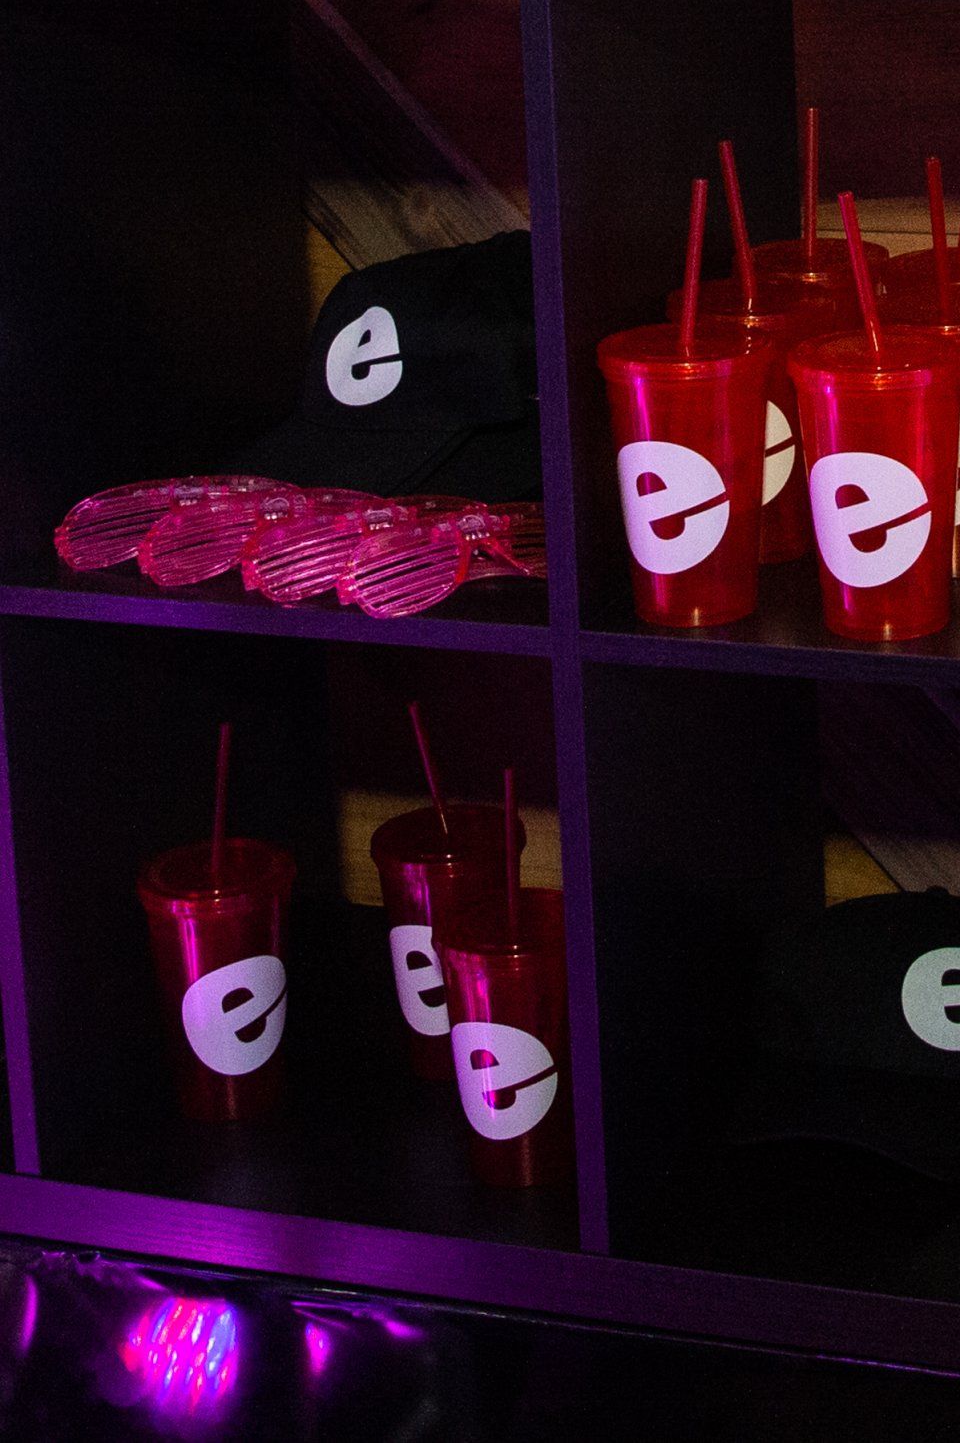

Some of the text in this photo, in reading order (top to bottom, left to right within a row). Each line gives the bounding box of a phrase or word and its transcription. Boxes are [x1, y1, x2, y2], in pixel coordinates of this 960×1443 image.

[326, 306, 402, 406] e
[617, 441, 730, 575] e
[810, 452, 931, 588] e
[182, 955, 288, 1076] e
[451, 1022, 558, 1140] e
